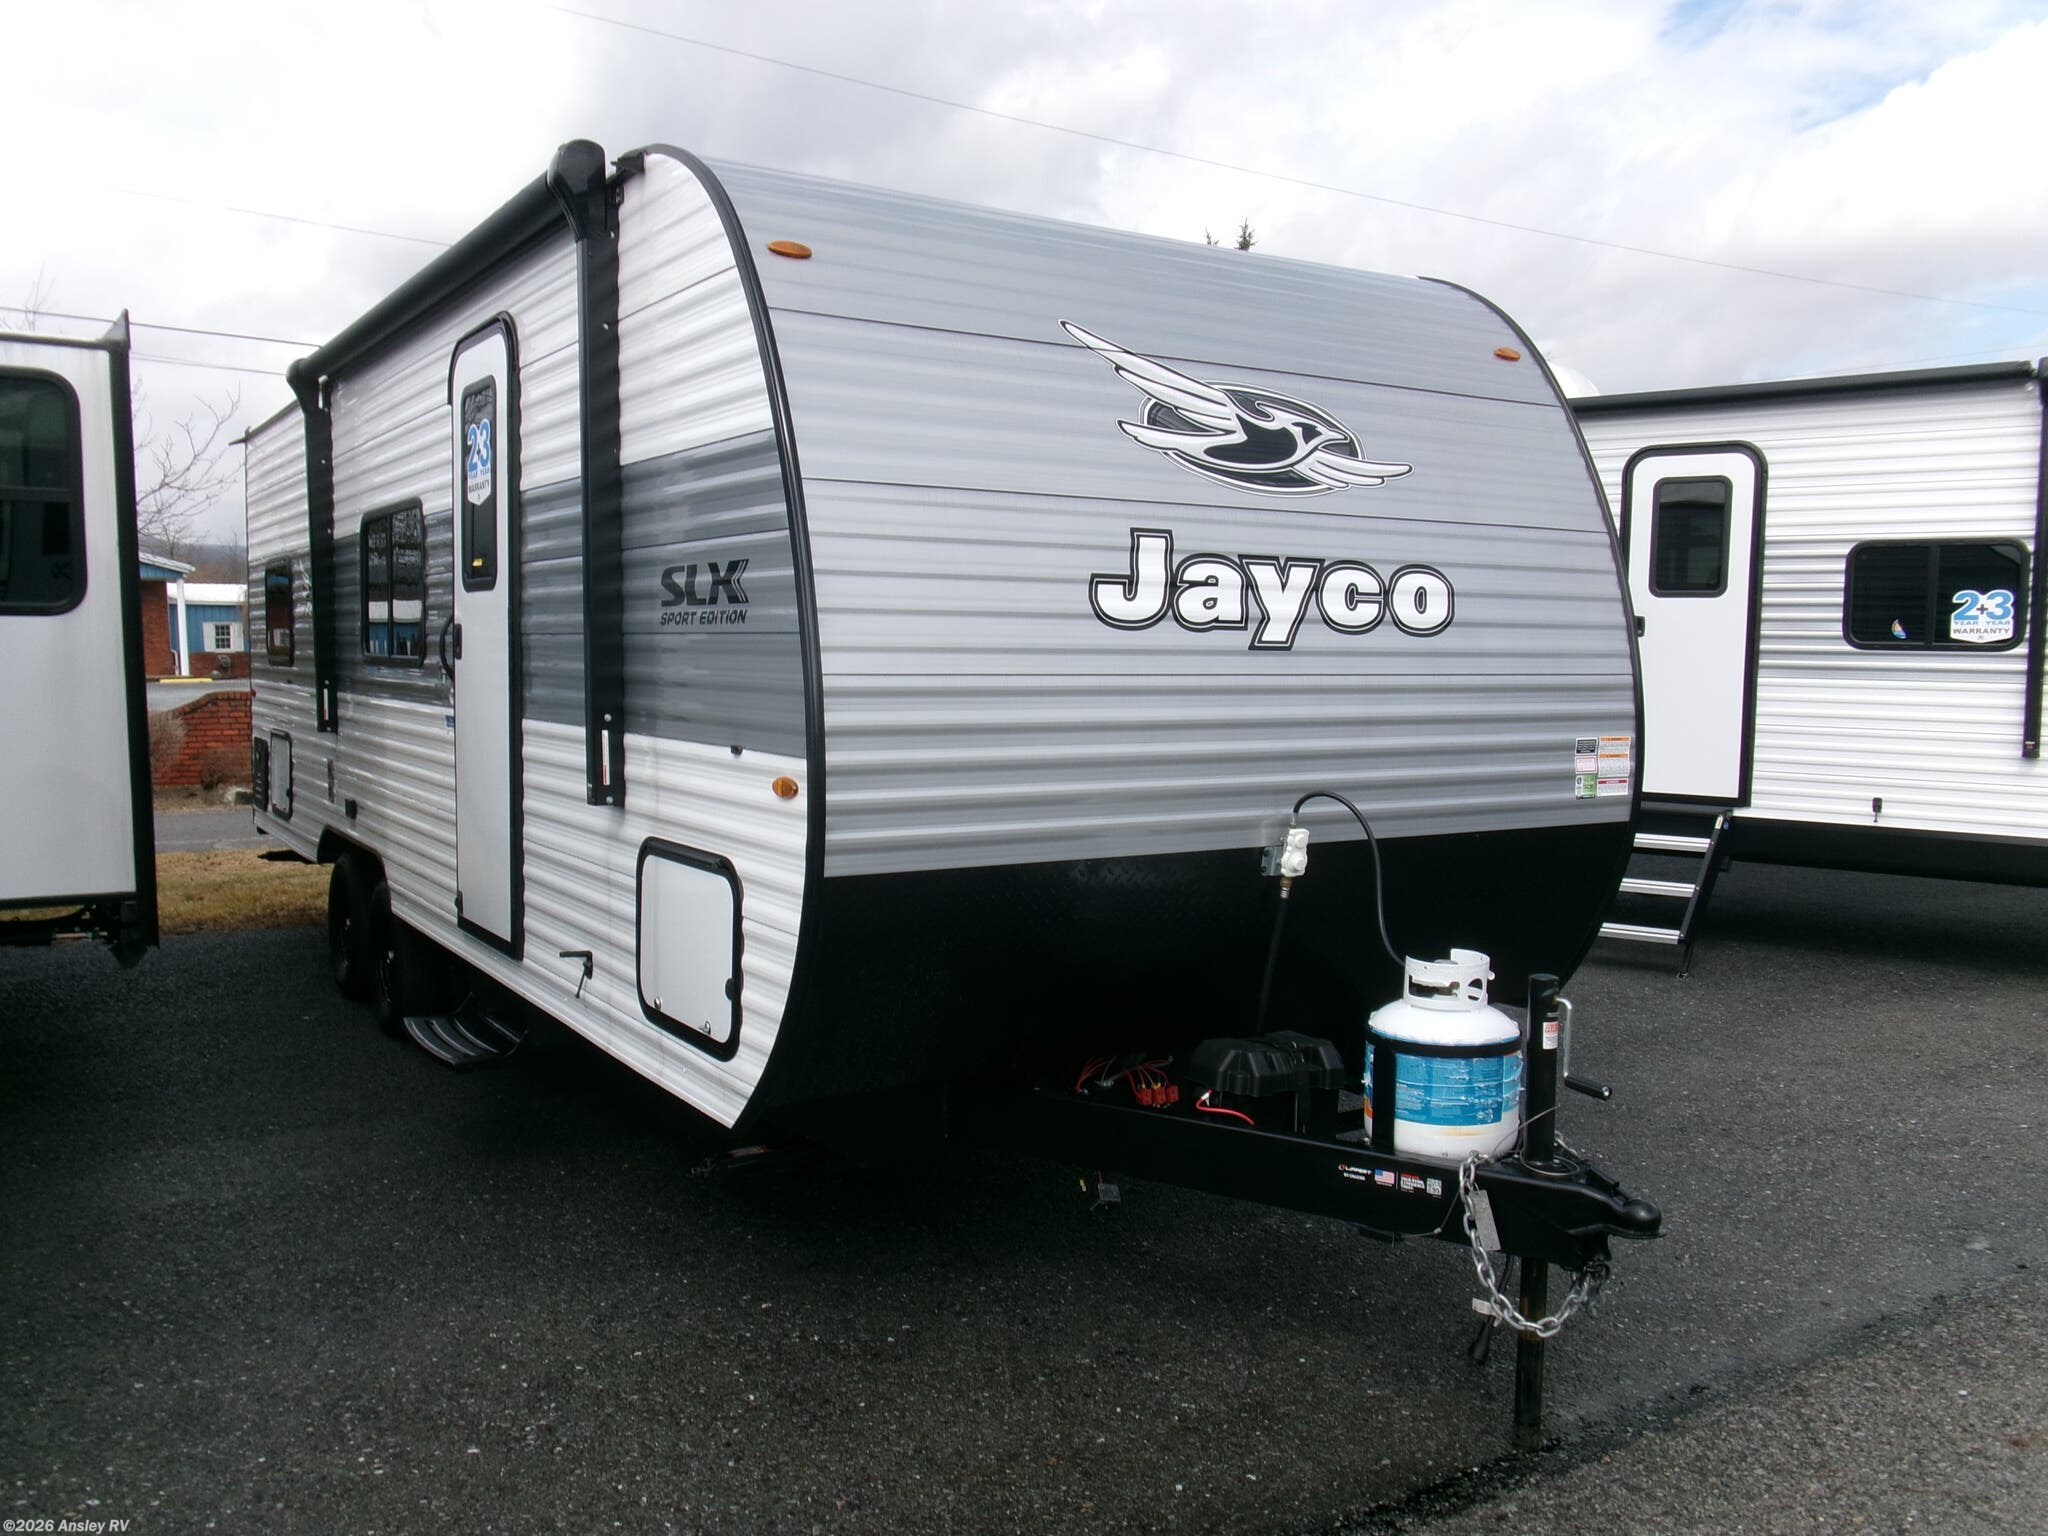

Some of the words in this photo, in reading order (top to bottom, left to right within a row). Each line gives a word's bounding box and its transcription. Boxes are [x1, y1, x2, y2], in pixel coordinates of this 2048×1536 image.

[660, 611, 697, 626] SPORT
[699, 609, 747, 625] EDITION
[1089, 527, 1454, 651] Jayco
